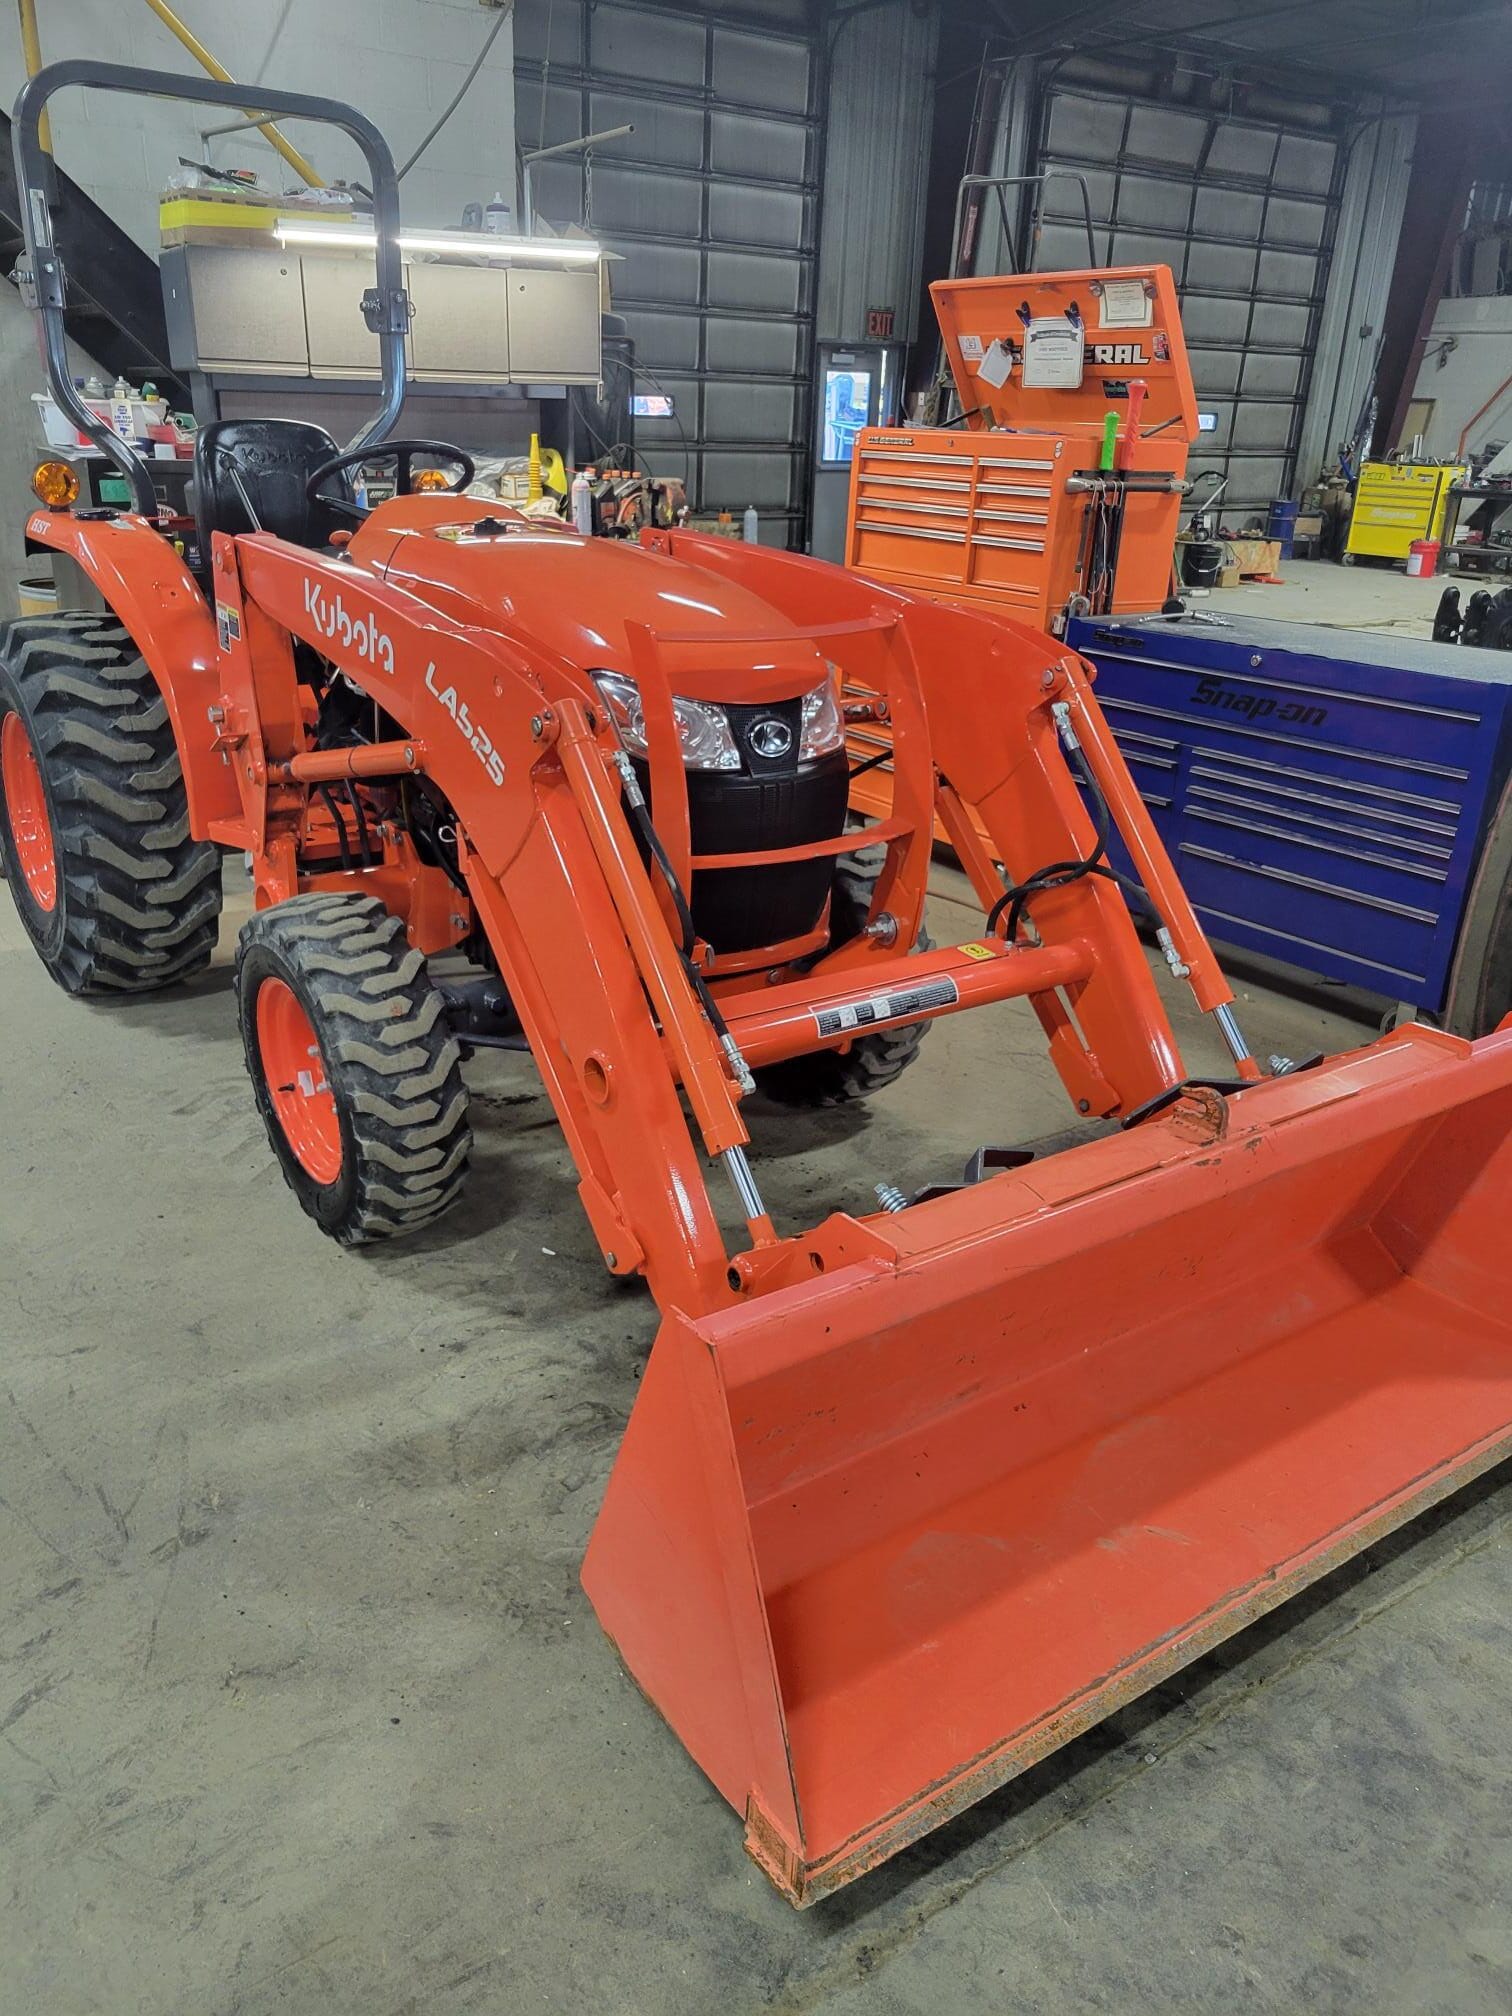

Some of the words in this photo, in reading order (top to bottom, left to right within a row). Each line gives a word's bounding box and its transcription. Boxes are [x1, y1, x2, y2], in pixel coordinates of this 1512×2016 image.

[868, 312, 893, 336] EXIT
[31, 518, 51, 535] HST
[304, 577, 394, 674] Kubota
[425, 661, 505, 786] LA525
[1189, 677, 1328, 727] Snap-on
